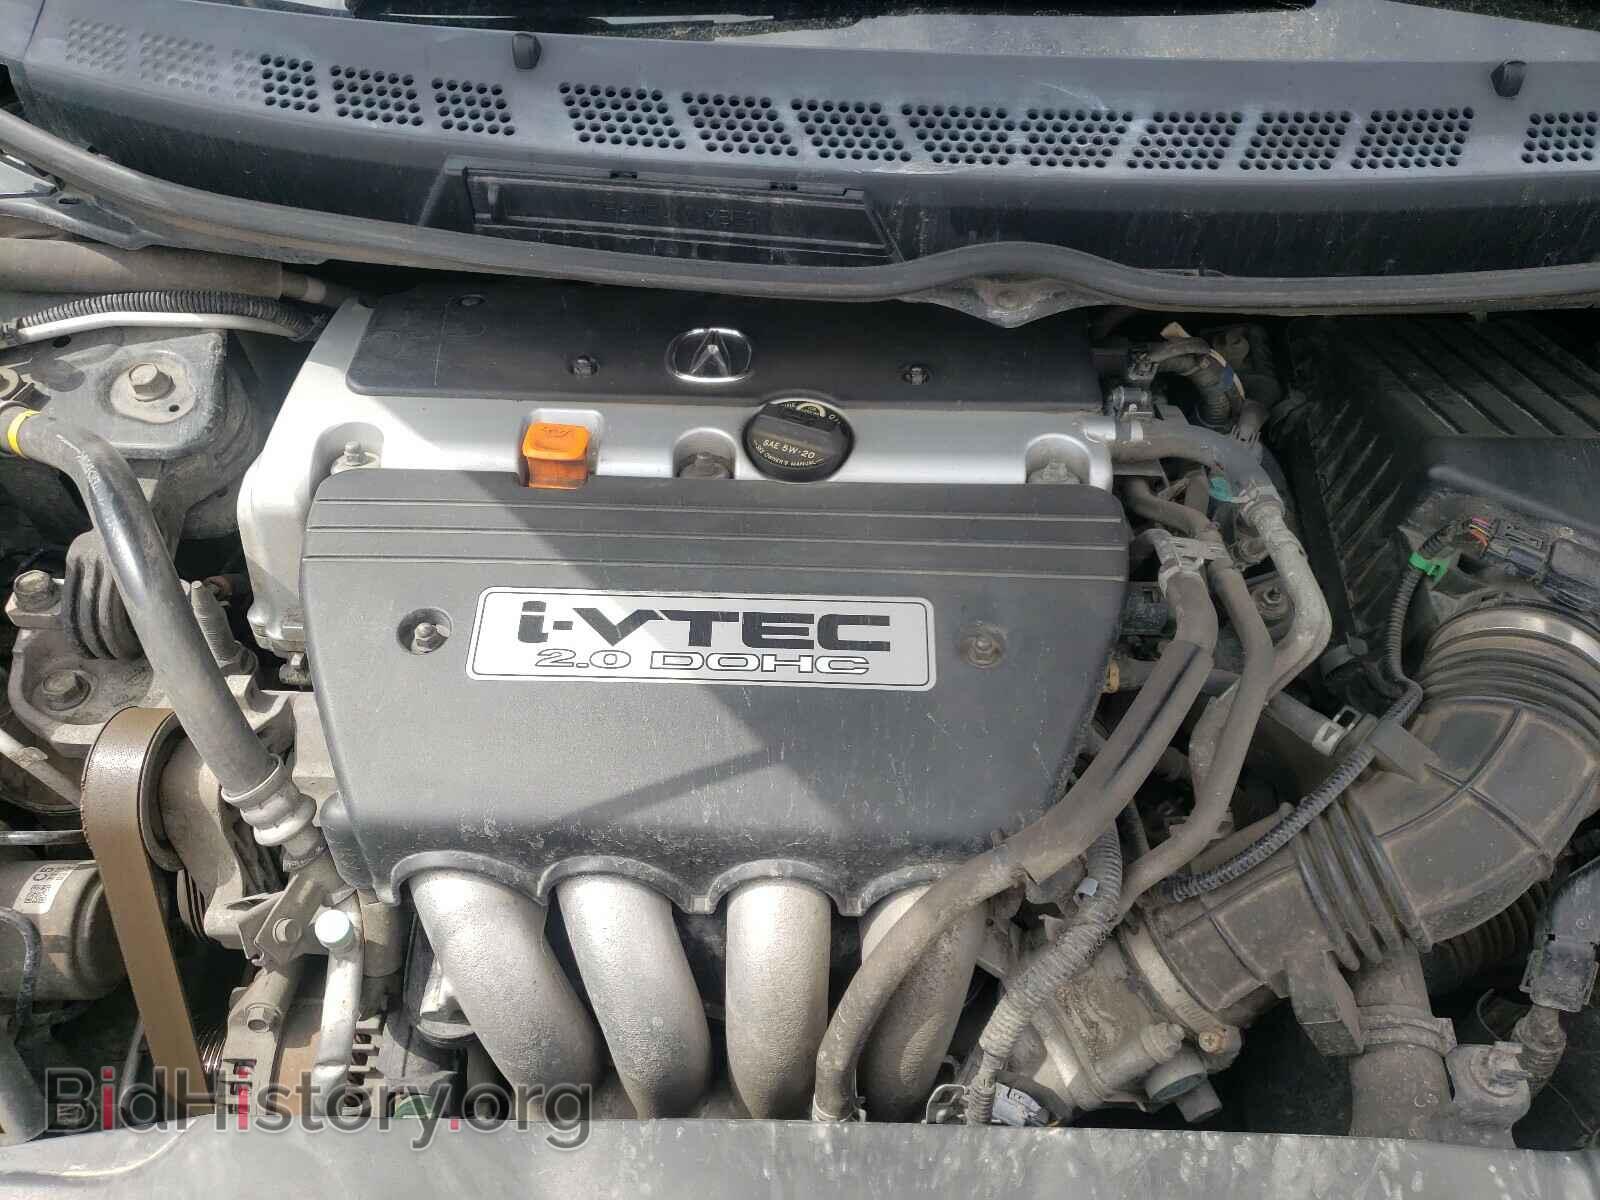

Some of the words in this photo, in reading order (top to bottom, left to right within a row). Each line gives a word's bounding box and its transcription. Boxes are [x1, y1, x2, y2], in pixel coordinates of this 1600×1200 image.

[763, 439, 781, 450] SAE
[517, 600, 891, 651] i-VTEC
[534, 648, 632, 669] 2.0
[650, 650, 870, 675] DOHC
